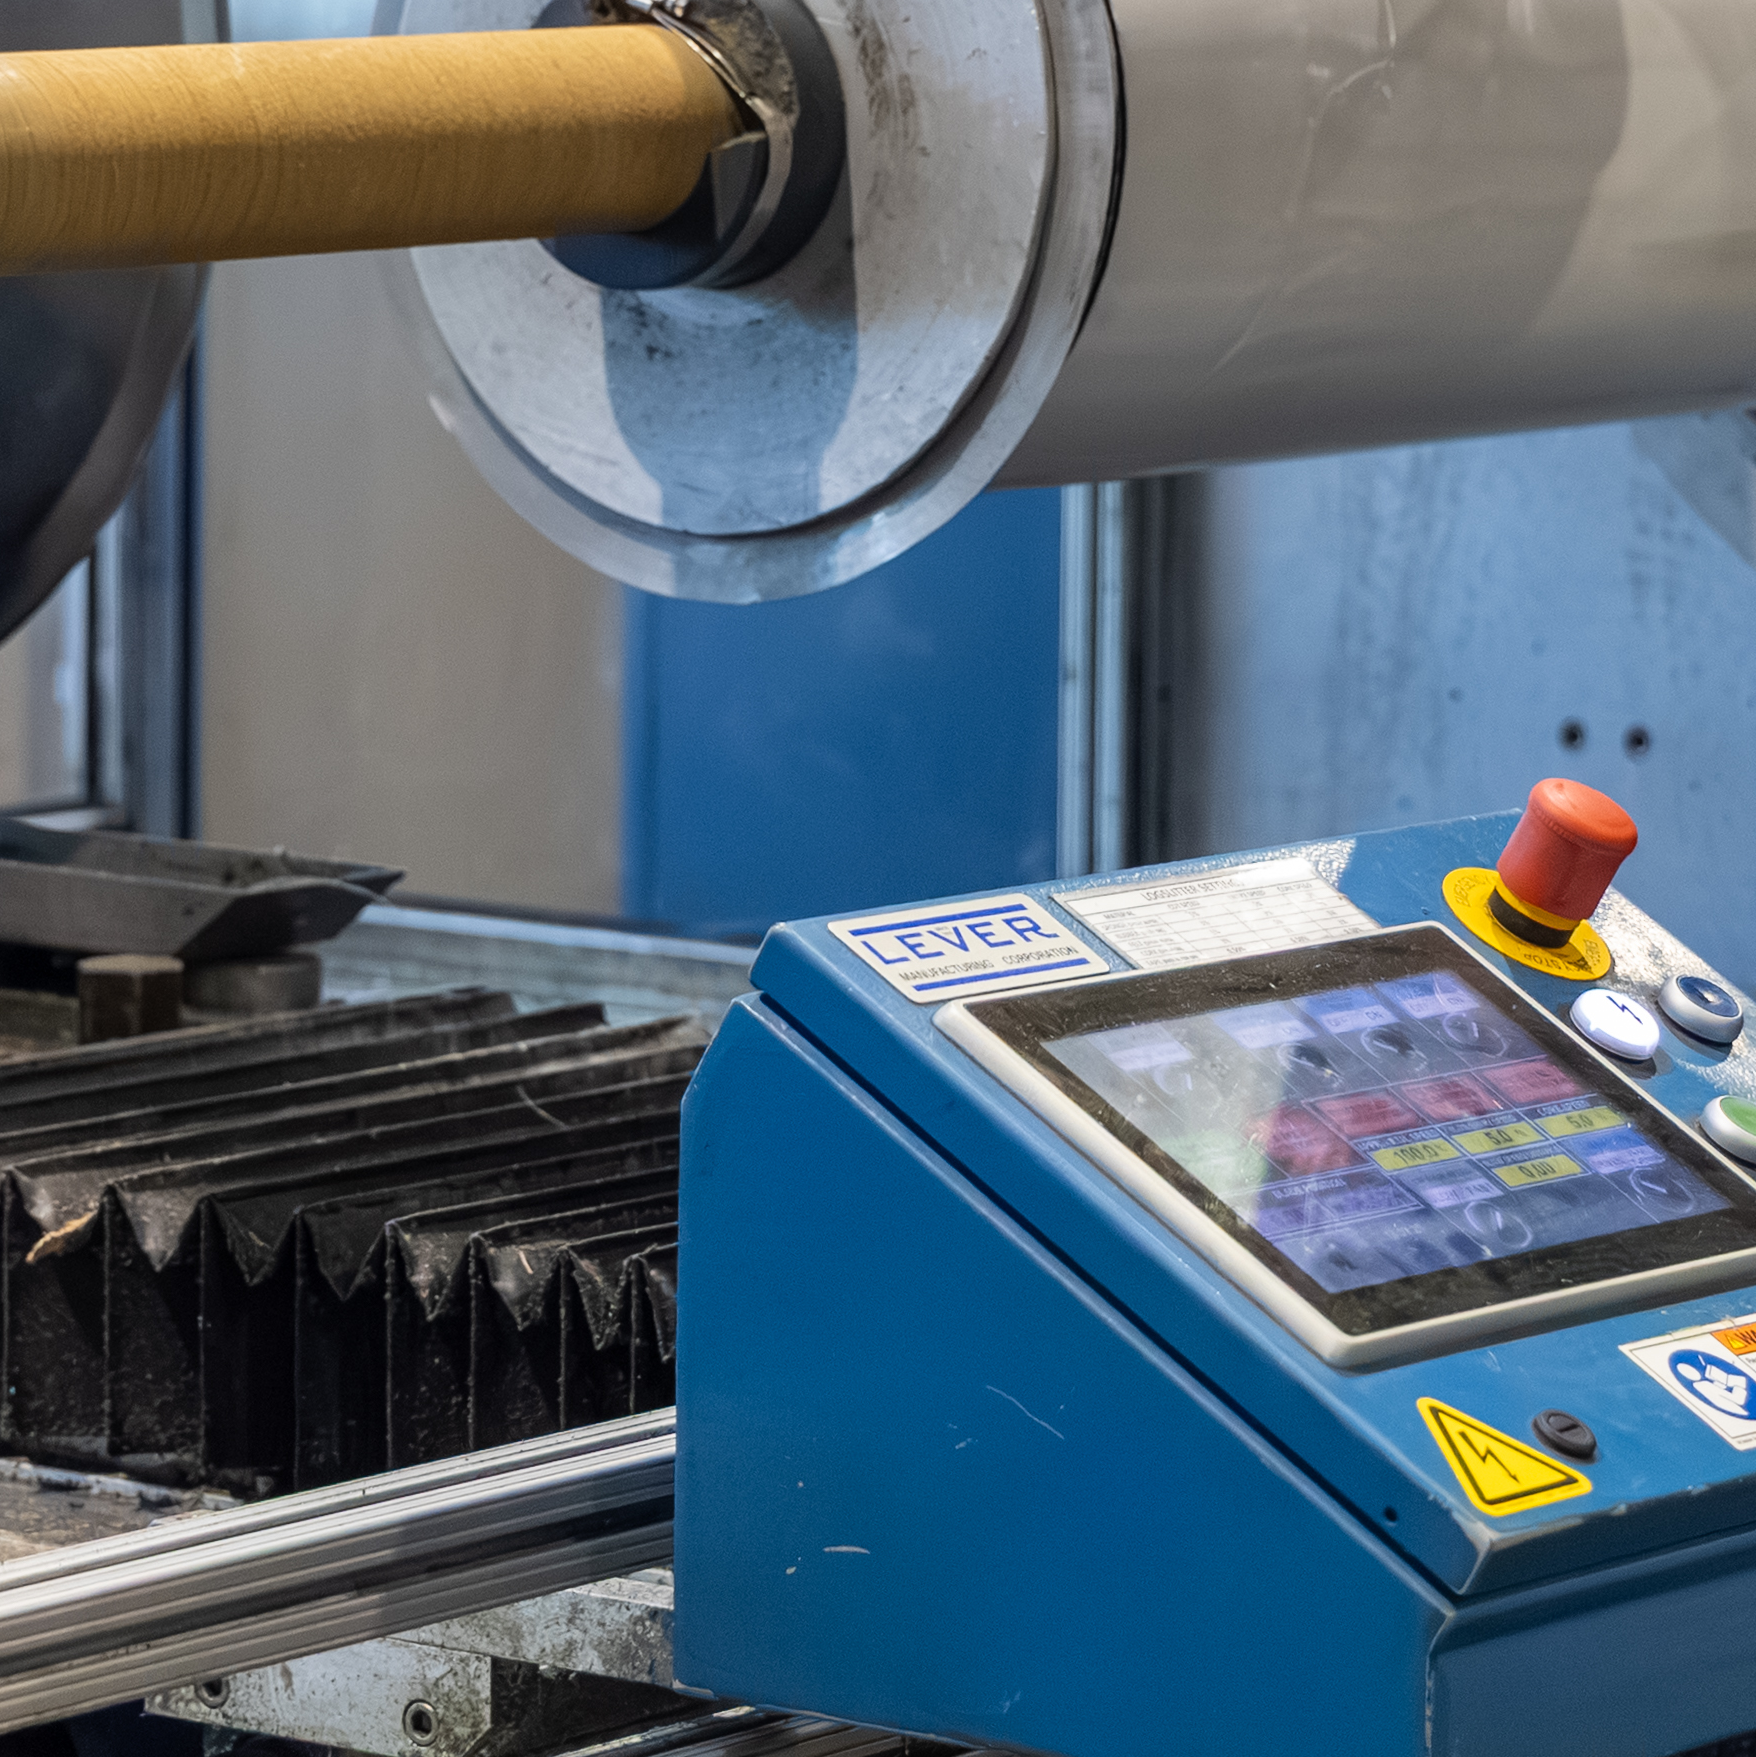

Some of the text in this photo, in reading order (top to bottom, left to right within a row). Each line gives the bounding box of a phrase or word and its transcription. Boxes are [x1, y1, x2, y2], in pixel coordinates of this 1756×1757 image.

[1141, 885, 1199, 902] LOGSLITTER
[861, 915, 1061, 966] LEVER
[899, 945, 1079, 982] MANUFACTURING CORPORATION
[1566, 1114, 1595, 1129] 5.0
[1485, 1128, 1514, 1146] 5.0
[1394, 1143, 1438, 1166] 100.0
